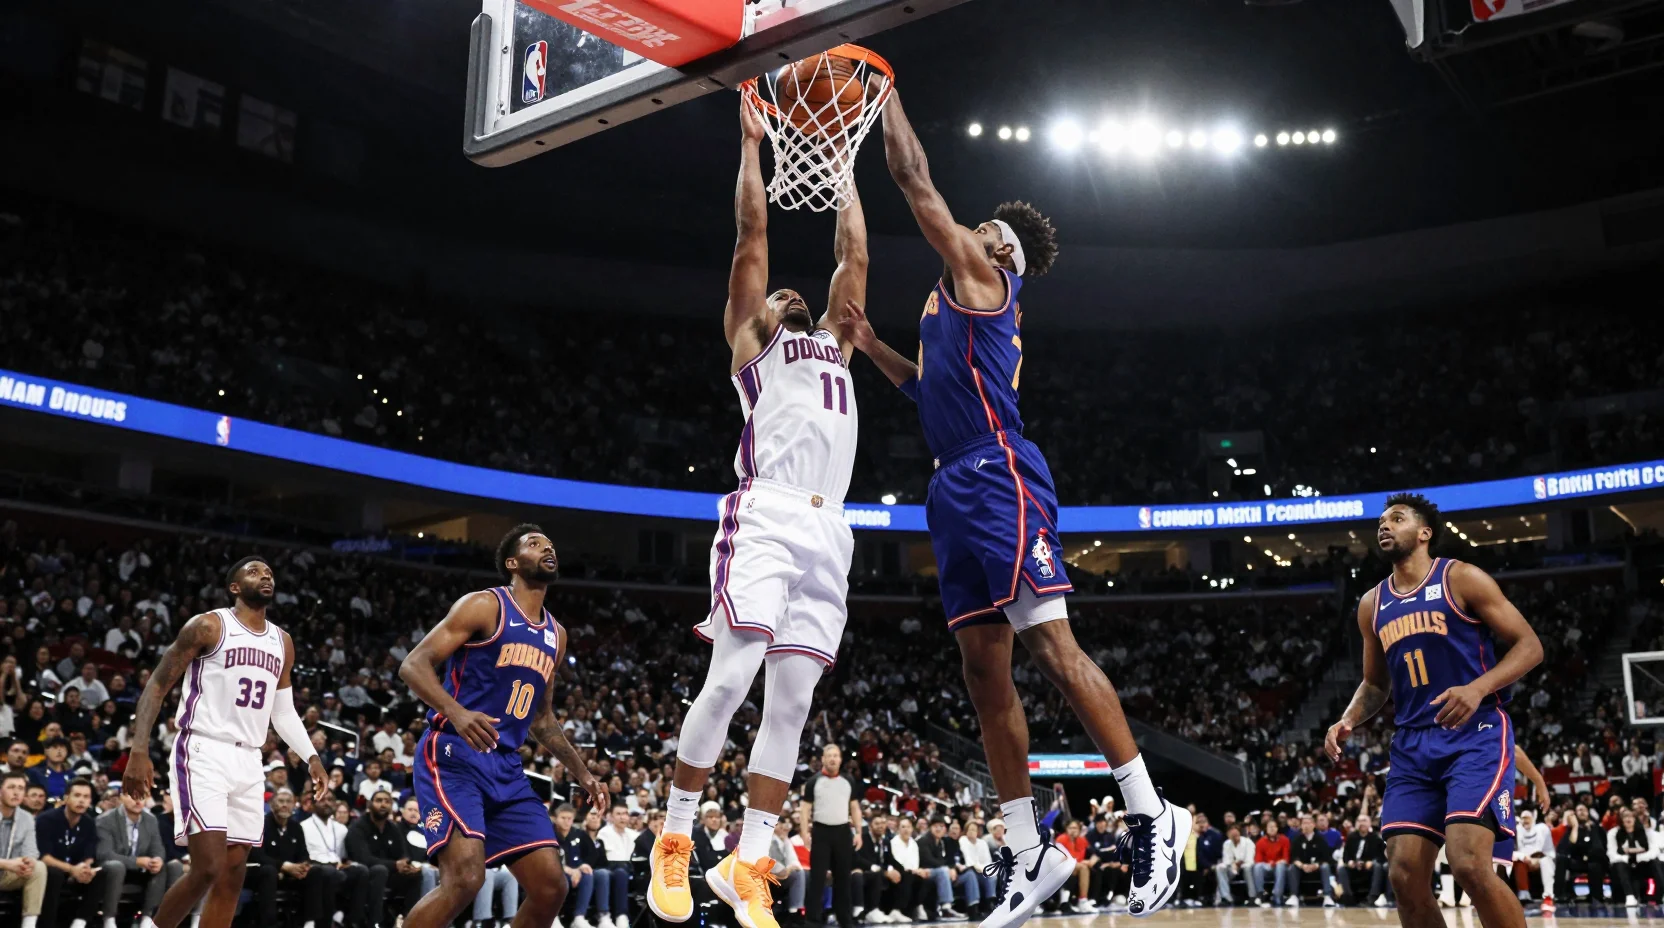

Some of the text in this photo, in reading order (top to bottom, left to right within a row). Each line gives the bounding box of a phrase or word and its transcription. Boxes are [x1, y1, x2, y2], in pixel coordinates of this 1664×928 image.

[820, 371, 848, 415] 11
[1404, 648, 1429, 688] 11
[235, 677, 267, 710] 33
[505, 680, 535, 720] 10
